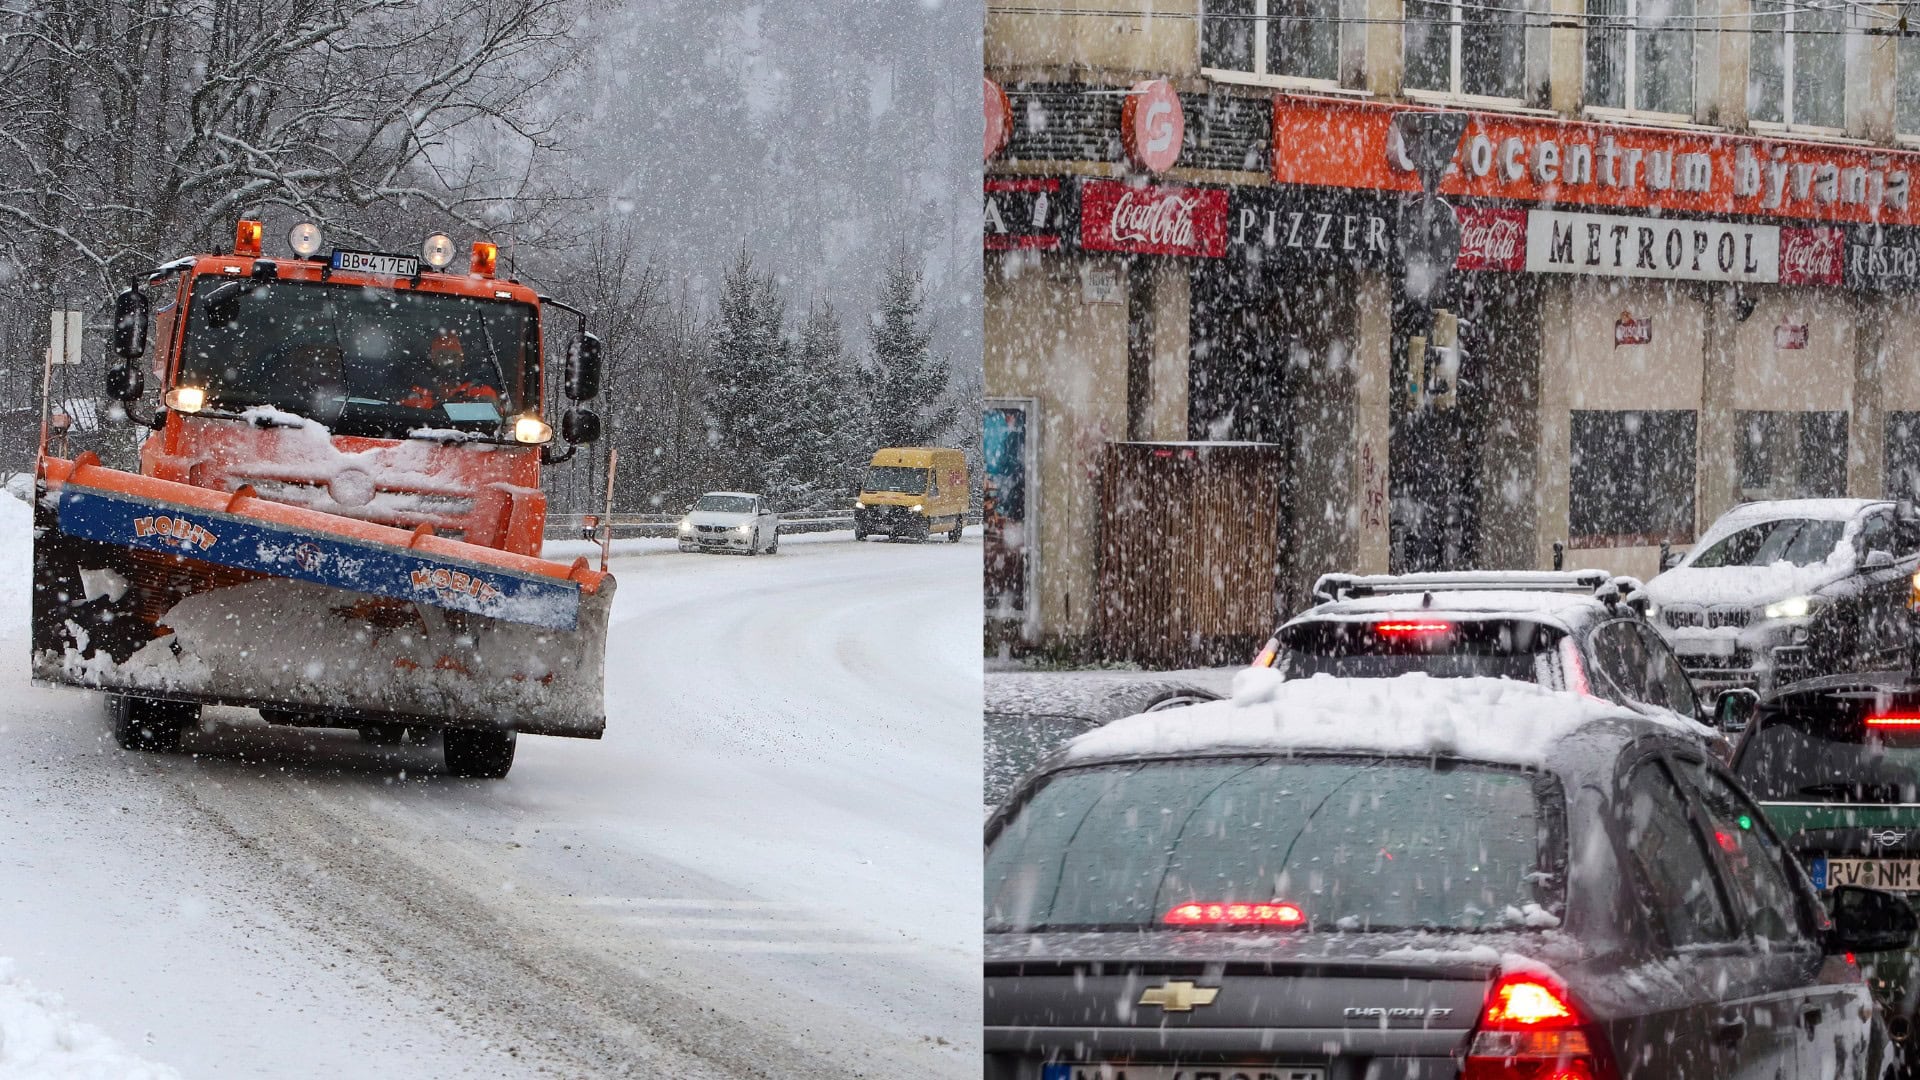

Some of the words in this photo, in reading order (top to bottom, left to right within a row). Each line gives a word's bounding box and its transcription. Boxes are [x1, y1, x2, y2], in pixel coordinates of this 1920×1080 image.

[1388, 118, 1713, 193] ocentrum
[1237, 208, 1389, 251] PIZZER
[1548, 219, 1758, 274] METROPOL
[342, 253, 360, 269] BB
[369, 256, 416, 274] 417EN
[133, 515, 218, 551] KOBIT
[411, 568, 497, 603] KOBIT
[1828, 862, 1861, 886] RV
[1343, 1007, 1454, 1017] CHEVROLET
